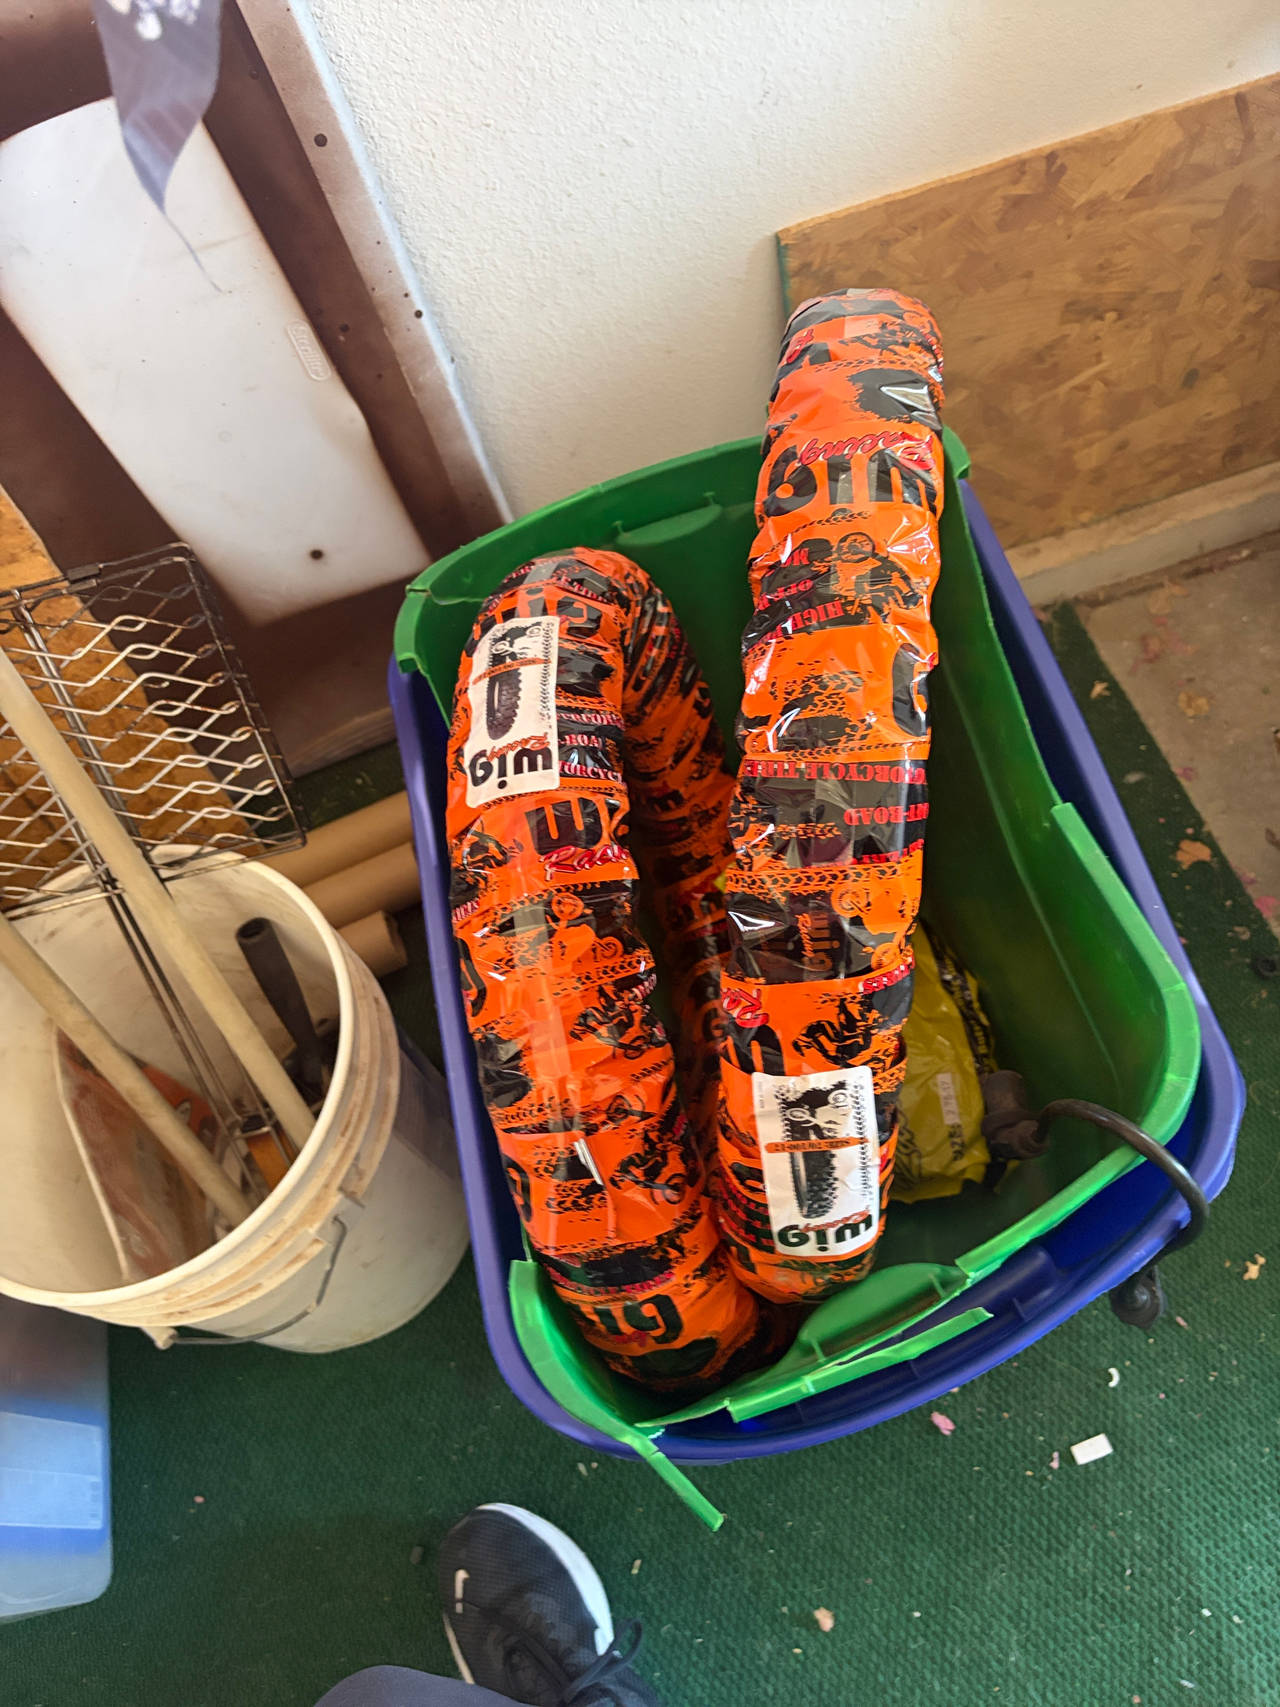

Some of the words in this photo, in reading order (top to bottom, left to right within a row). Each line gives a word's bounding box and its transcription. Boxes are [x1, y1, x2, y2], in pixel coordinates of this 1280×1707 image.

[486, 732, 551, 762] Racing
[468, 742, 555, 790] wig
[805, 761, 927, 785] OTORCYCLE
[777, 1213, 874, 1253] wig
